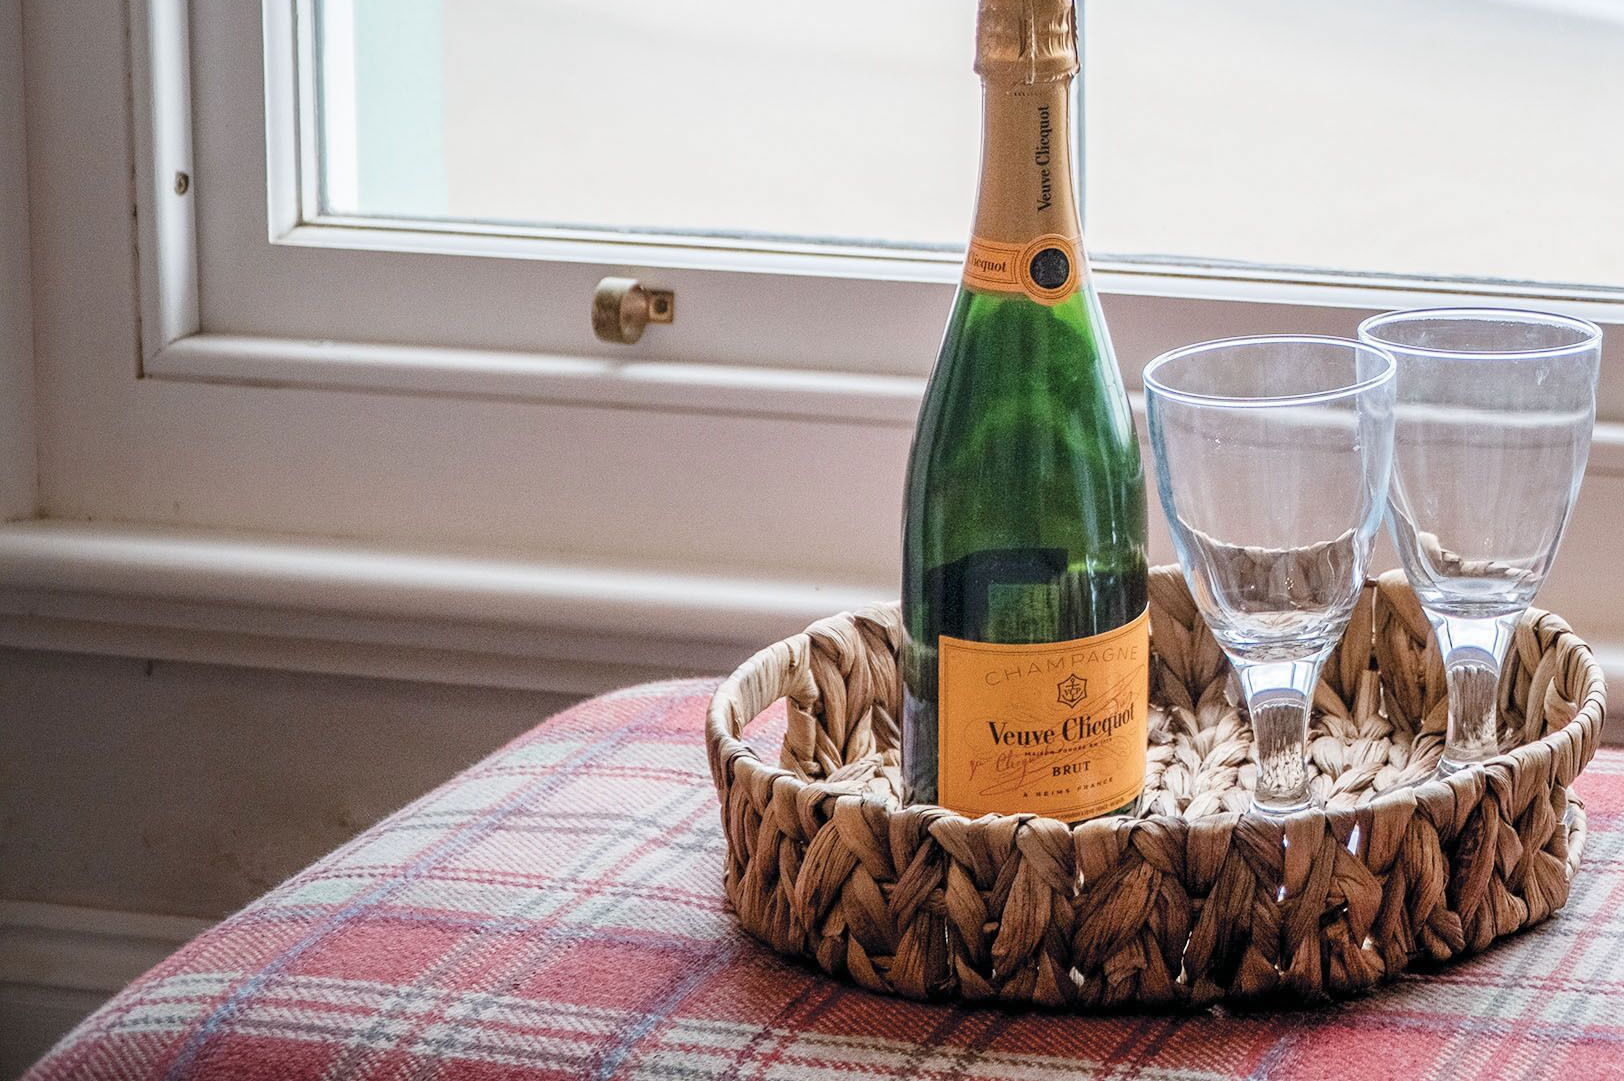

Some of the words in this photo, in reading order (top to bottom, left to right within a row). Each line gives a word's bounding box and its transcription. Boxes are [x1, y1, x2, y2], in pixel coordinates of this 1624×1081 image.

[1035, 104, 1052, 166] Clicquot
[1037, 168, 1052, 213] Veuve
[985, 646, 1137, 686] CHAMPAGNE
[987, 721, 1055, 746] Veuve
[1062, 703, 1134, 742] Clicquot
[1052, 761, 1091, 777] BRUT
[1077, 777, 1113, 790] FRANCE
